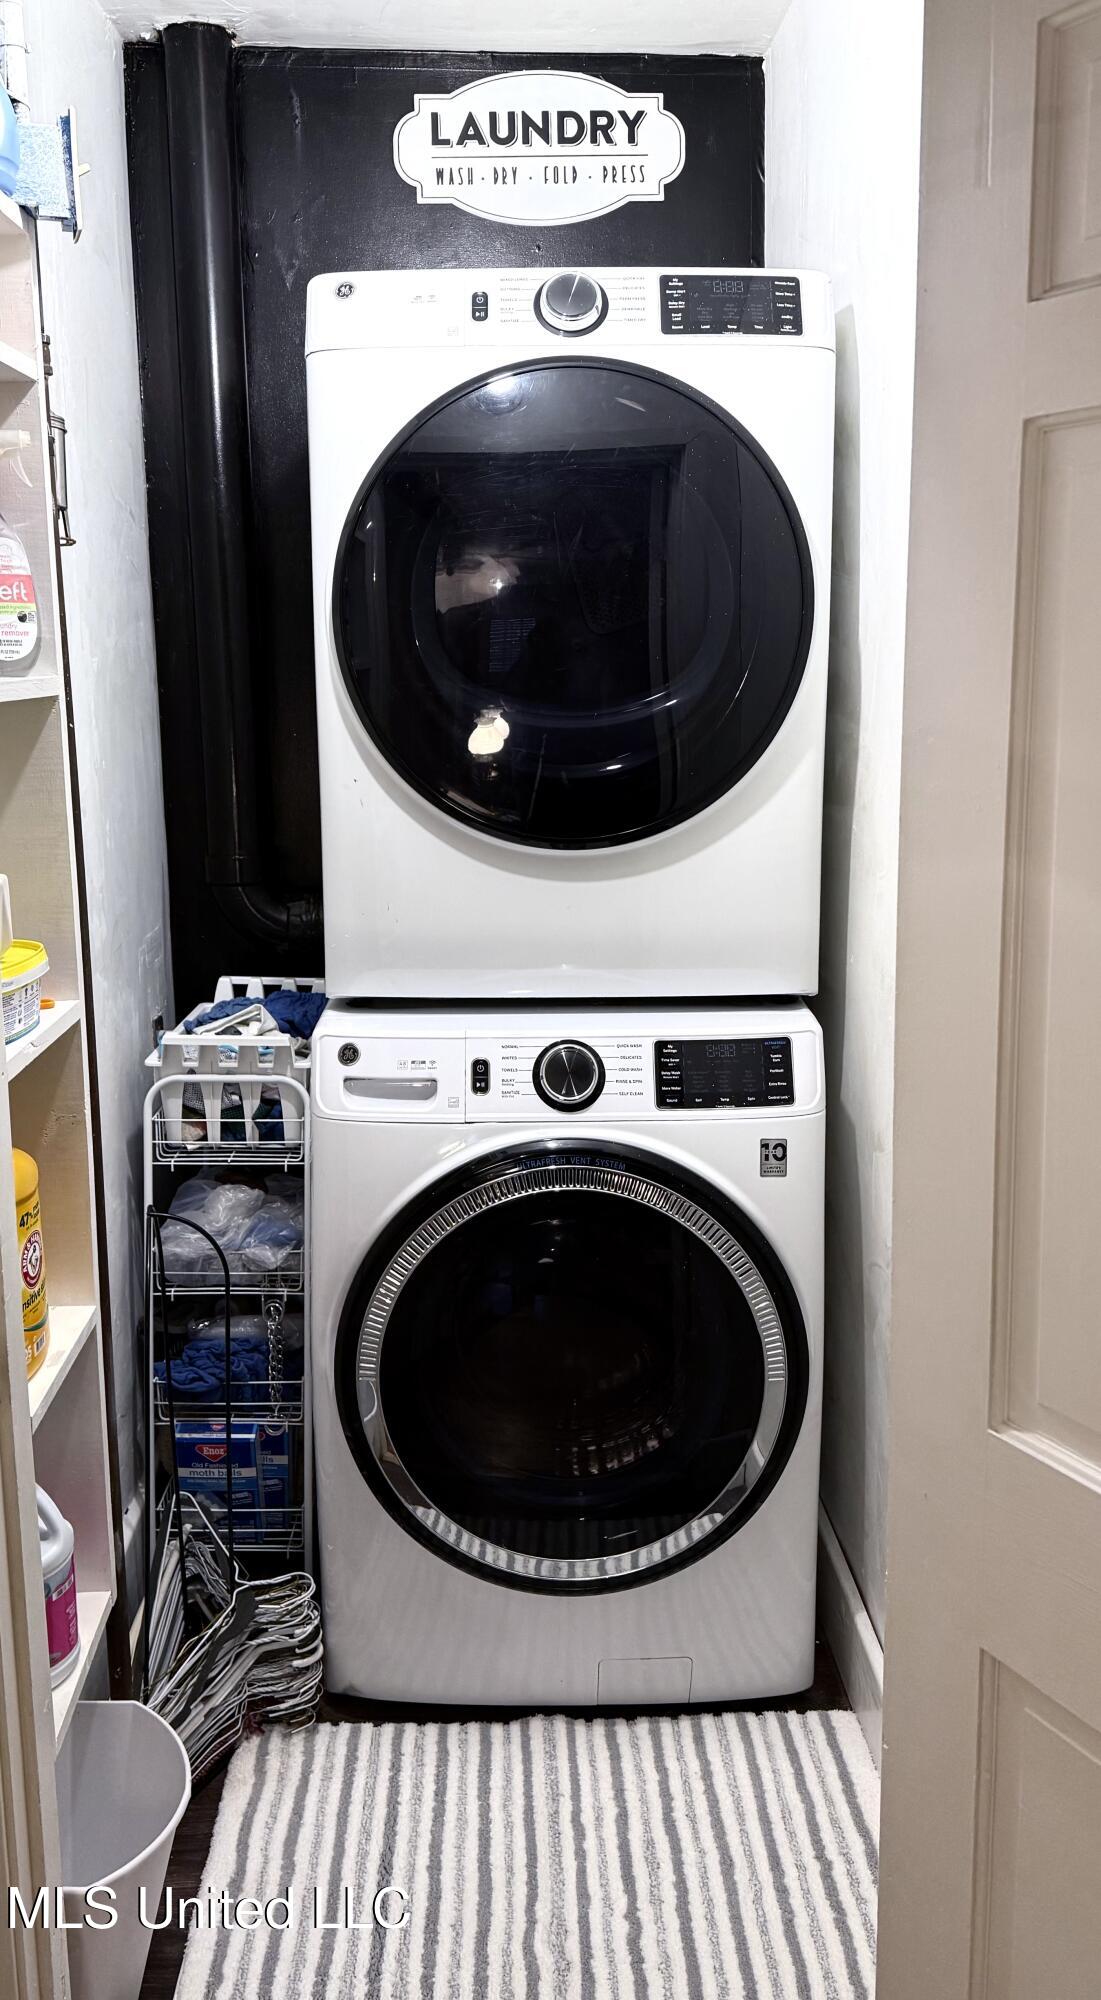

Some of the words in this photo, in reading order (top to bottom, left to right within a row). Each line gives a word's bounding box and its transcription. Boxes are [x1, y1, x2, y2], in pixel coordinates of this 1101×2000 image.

[430, 110, 648, 148] LAUNDRY
[435, 167, 474, 186] WASH
[493, 166, 518, 185] DRY
[544, 165, 578, 185] FOLD
[603, 165, 645, 184] PRESS
[761, 1143, 787, 1162] 10
[570, 1157, 592, 1165] VENT
[595, 1159, 626, 1171] SYSTEM
[203, 1447, 225, 1455] Enoz
